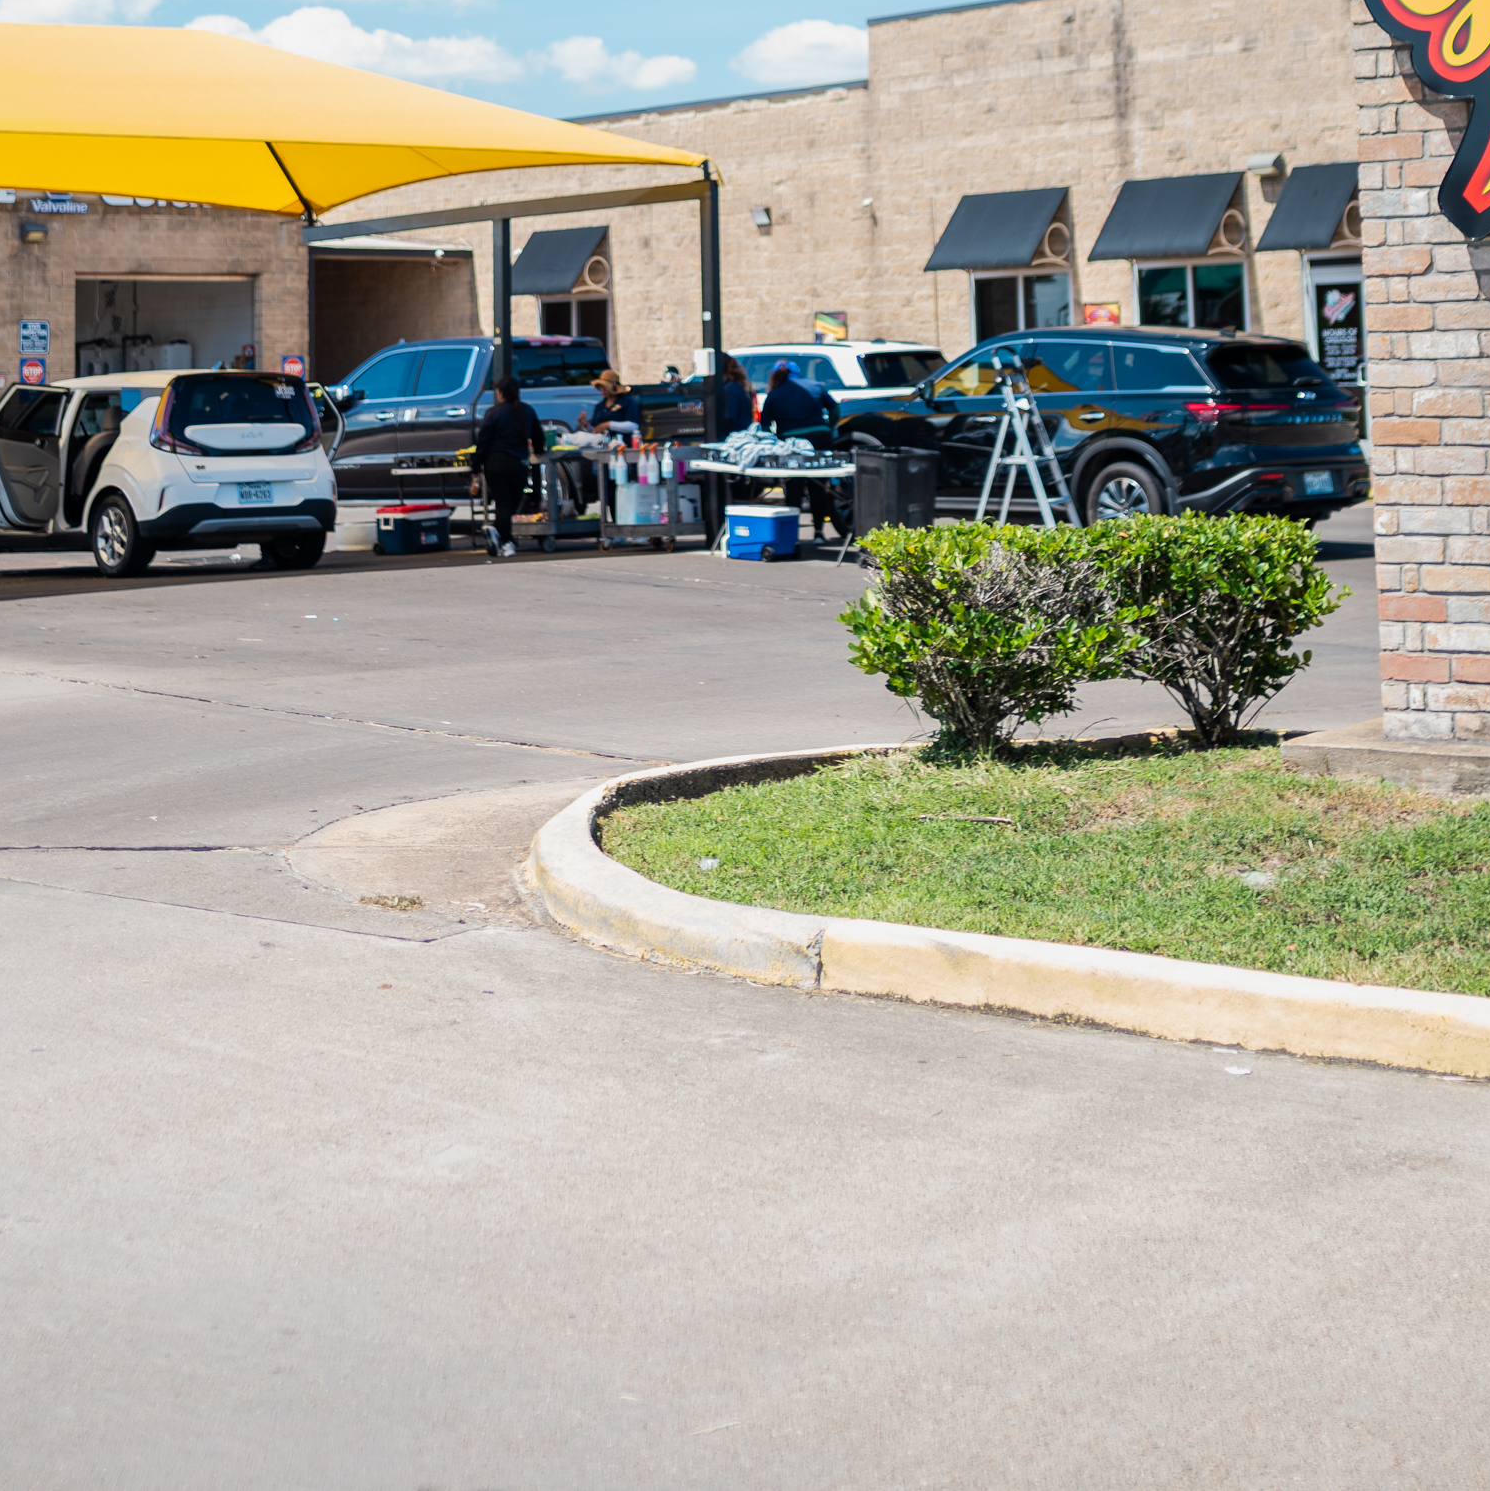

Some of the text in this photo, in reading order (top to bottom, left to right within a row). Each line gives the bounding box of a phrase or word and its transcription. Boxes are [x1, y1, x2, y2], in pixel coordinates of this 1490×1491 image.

[30, 197, 89, 214] Valvoline
[23, 365, 44, 377] STOP
[284, 363, 303, 373] STOP
